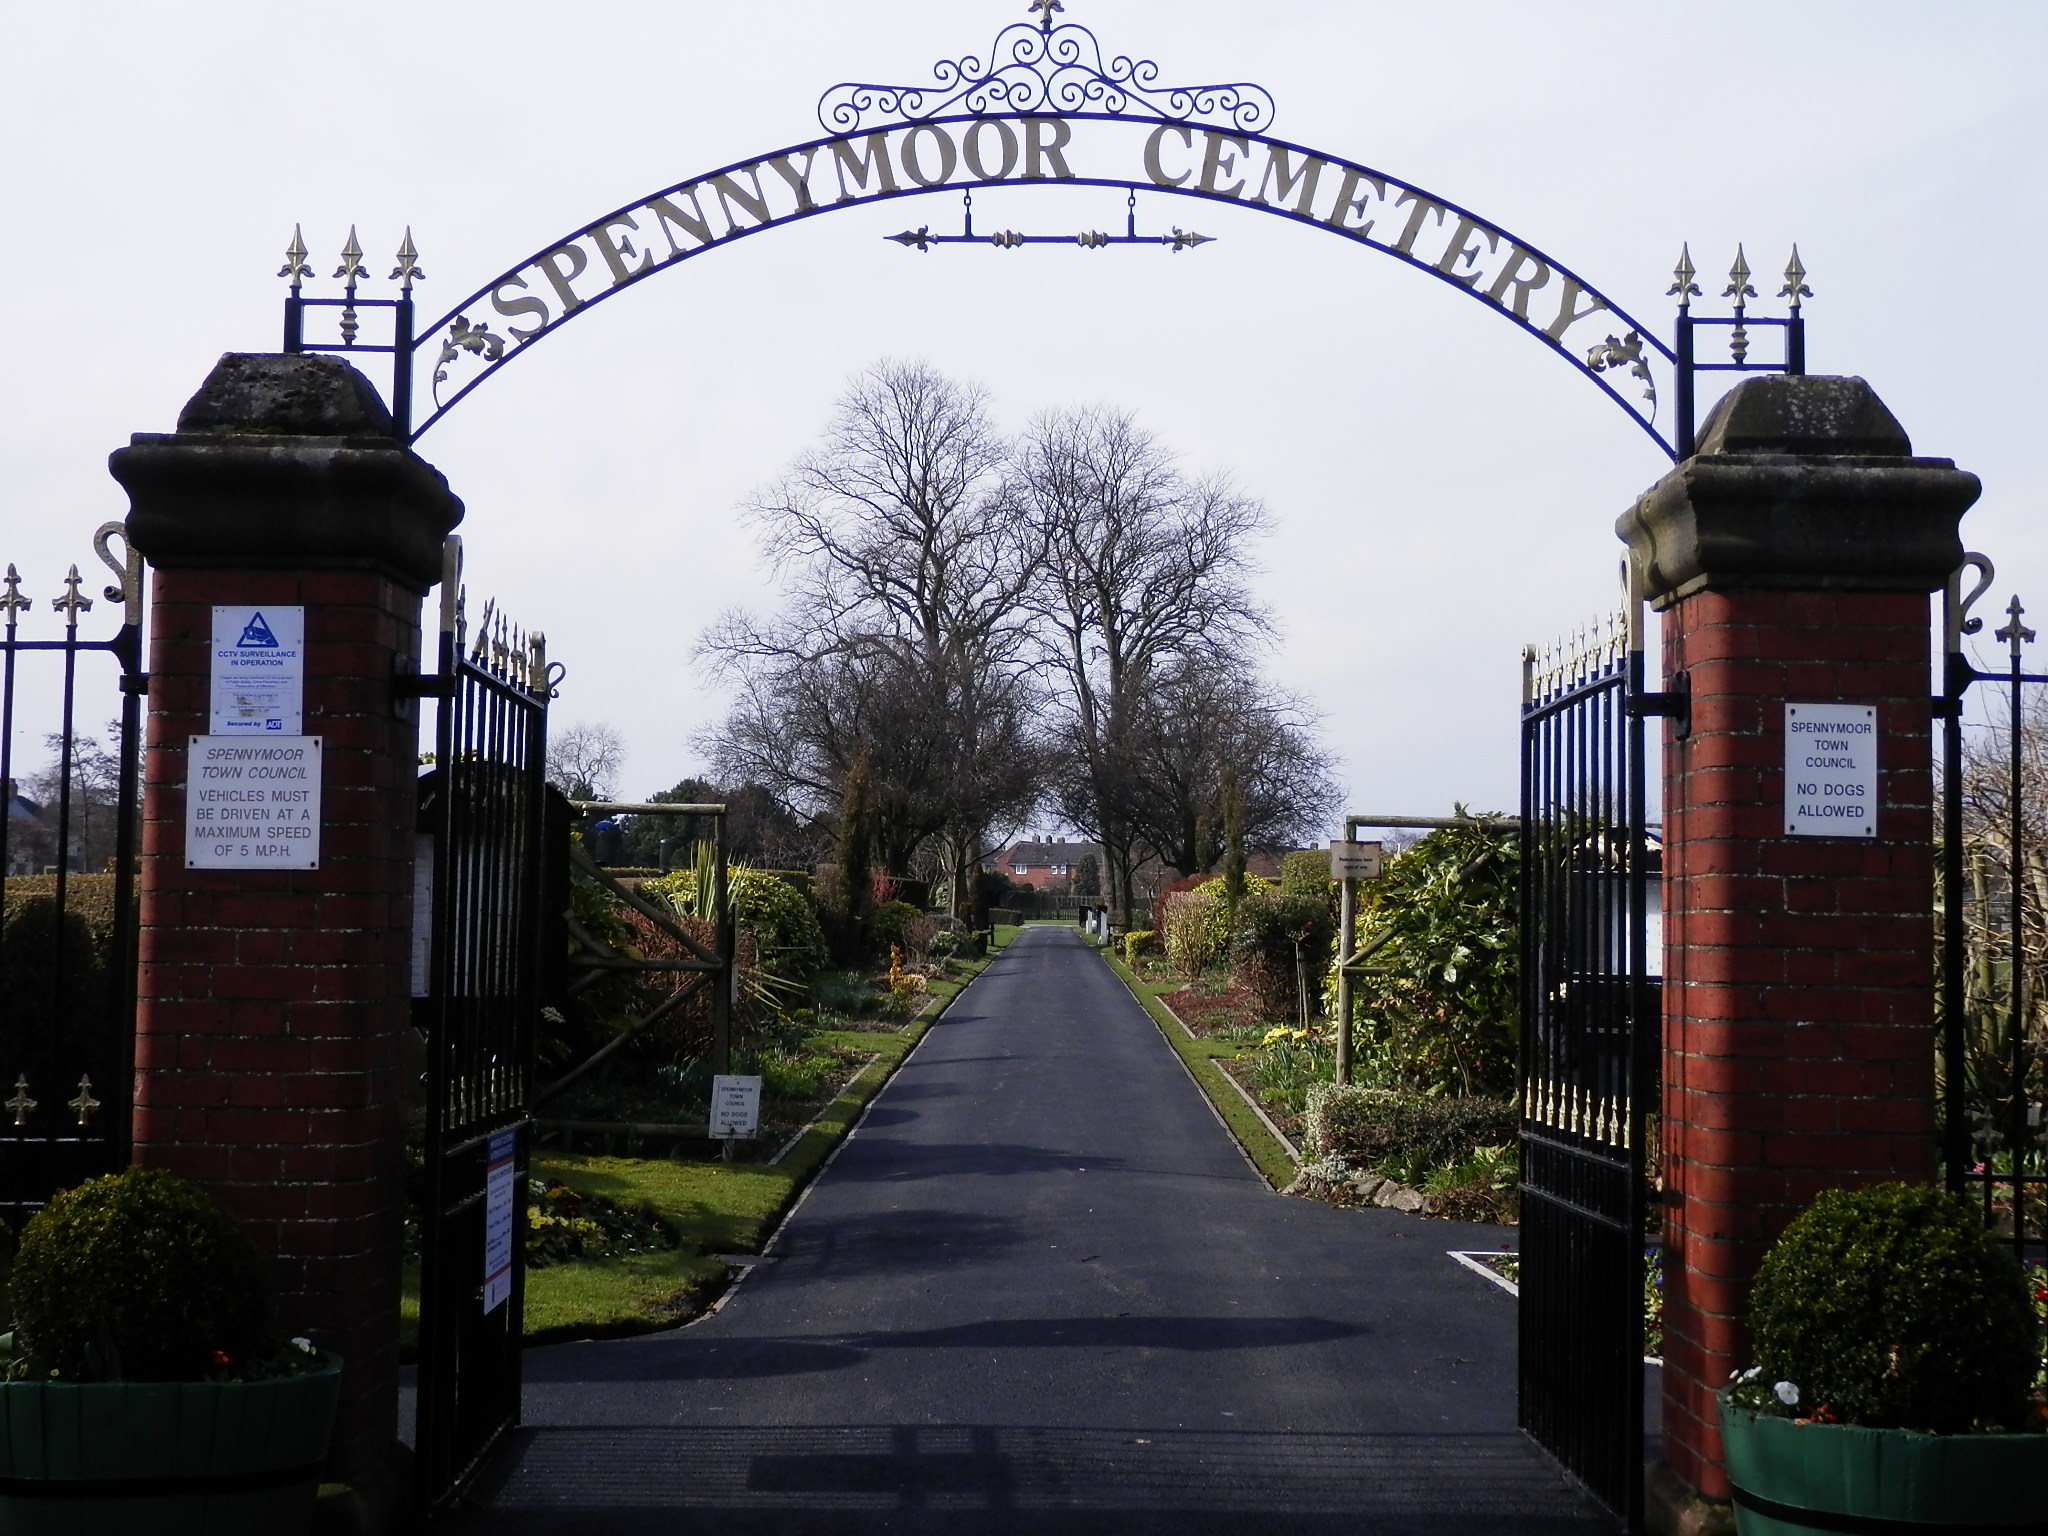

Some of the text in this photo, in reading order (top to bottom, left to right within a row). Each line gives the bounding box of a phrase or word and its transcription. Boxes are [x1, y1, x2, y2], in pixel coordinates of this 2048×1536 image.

[490, 117, 1609, 346] SPENNYMOOR CEMETERY
[266, 720, 281, 729] ADT
[1791, 722, 1871, 734] SPENNYMOOR
[1814, 740, 1848, 751] TOWN
[206, 748, 304, 761] SPENNYMOOR
[1805, 757, 1856, 769] COUNCIL
[202, 766, 308, 779] TOWN COUNCIL
[1797, 783, 1865, 796] NO DOGS
[199, 790, 310, 802] VEHICLES MUST
[196, 808, 310, 820] BE DRIVEN AT A
[1798, 805, 1864, 818] ALLOWED
[195, 826, 311, 839] MAXIMUM SPEED
[214, 845, 233, 856] OF
[240, 845, 249, 856] 5
